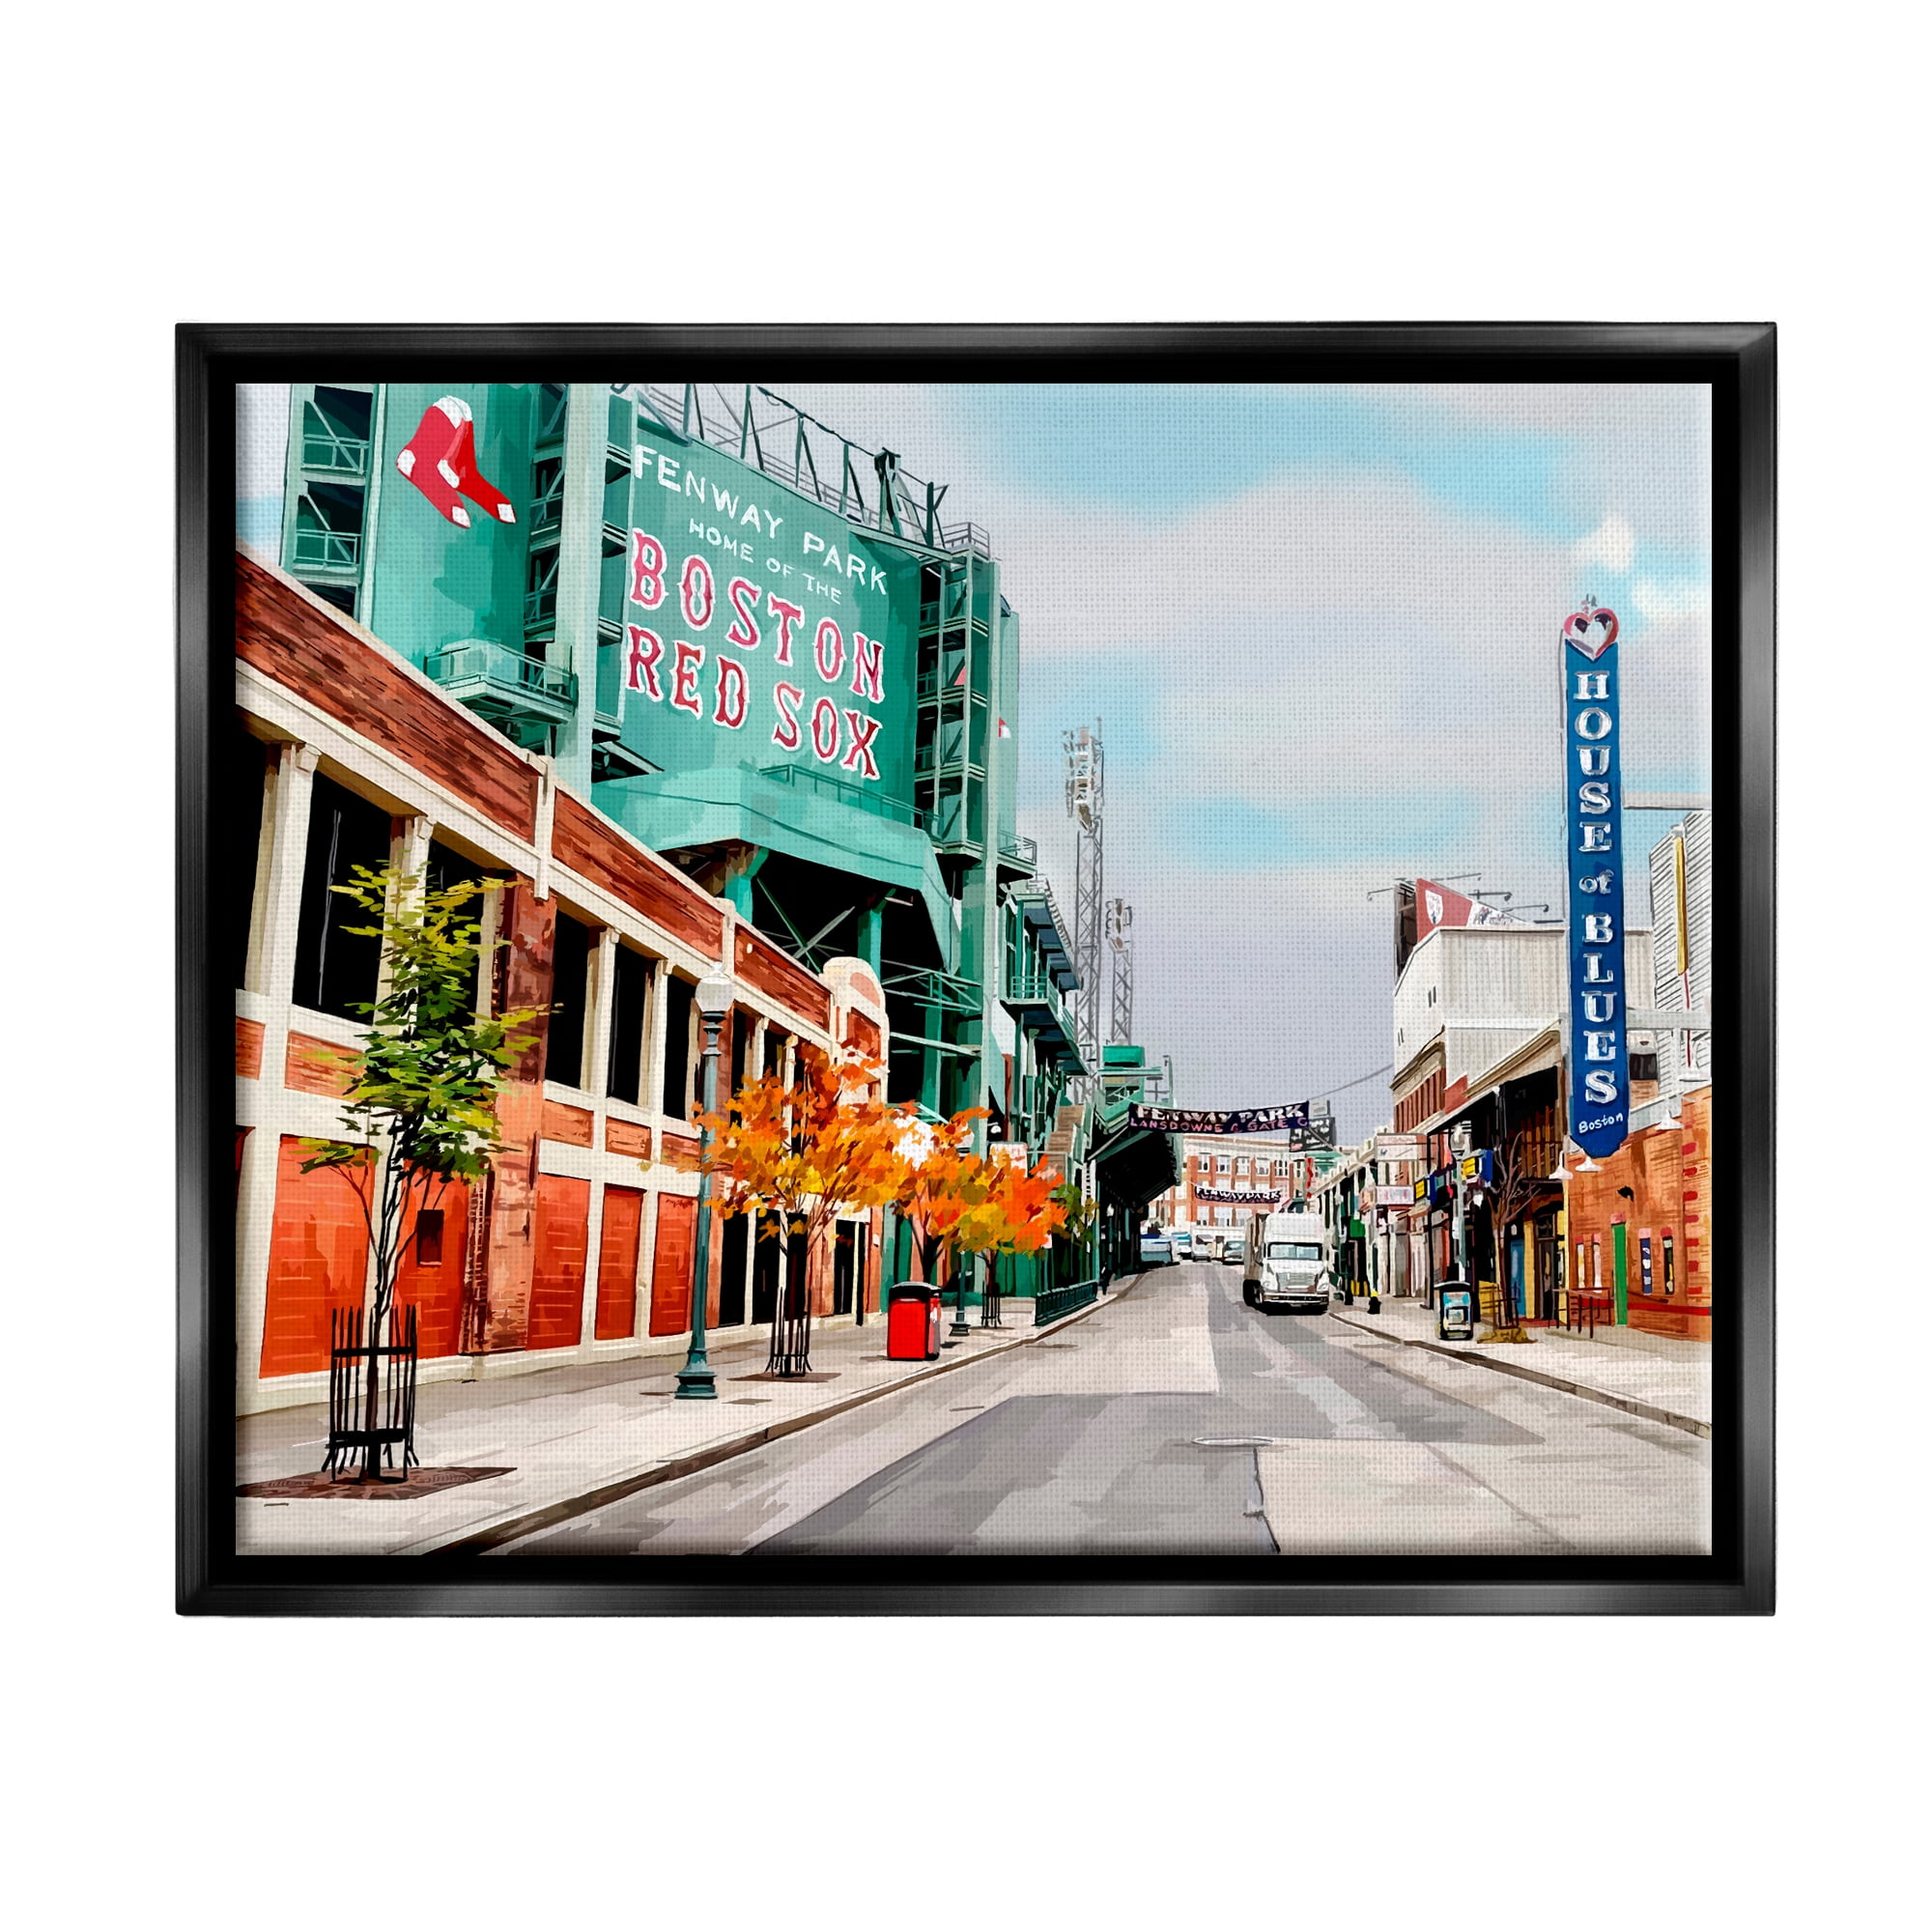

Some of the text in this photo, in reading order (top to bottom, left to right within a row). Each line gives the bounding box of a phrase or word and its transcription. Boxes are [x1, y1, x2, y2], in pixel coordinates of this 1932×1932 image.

[634, 444, 887, 595] FENWAY PARK
[689, 518, 841, 605] HOME OF THE
[630, 527, 885, 702] BOSTON
[627, 622, 883, 781] RED SOX
[1574, 670, 1618, 1104] HOUSE of BLUES
[1129, 1117, 1224, 1133] LANSDOWNE
[1247, 1118, 1289, 1131] GATE
[1136, 1104, 1304, 1123] FENWAY PARK
[1578, 1112, 1624, 1134] Boston
